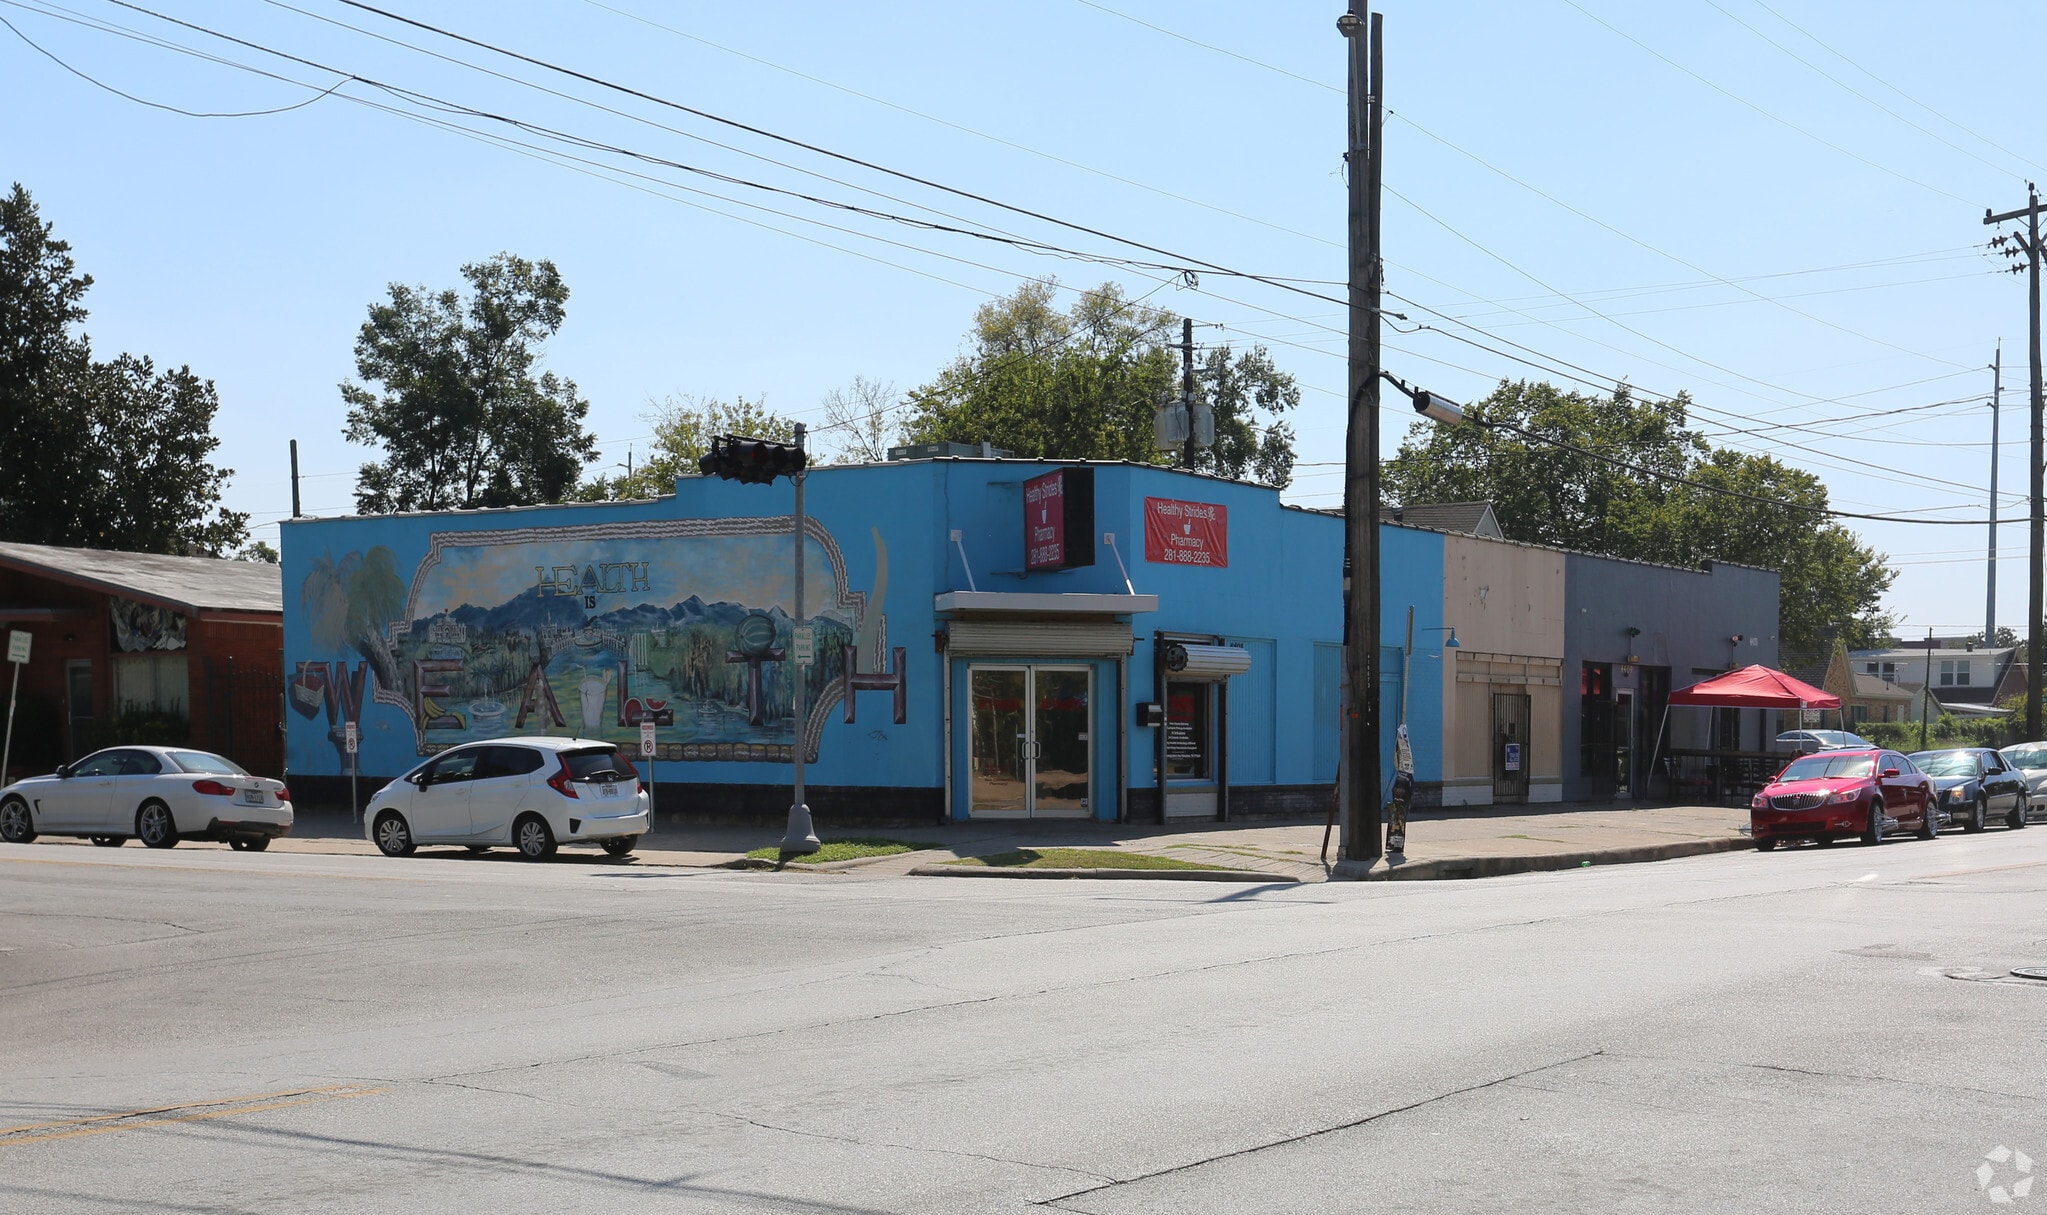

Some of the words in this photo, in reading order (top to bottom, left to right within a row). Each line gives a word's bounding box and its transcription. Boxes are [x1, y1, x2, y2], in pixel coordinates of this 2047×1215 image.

[1026, 485, 1041, 504] Healthy
[1042, 481, 1057, 499] Strides
[1157, 502, 1183, 519] Healthy
[1184, 504, 1207, 519] Strides
[1034, 526, 1055, 542] Pharmacy
[1170, 533, 1204, 550] Pharmacy
[1164, 548, 1210, 563] 281-888-2235
[535, 562, 651, 598] HEALTH
[585, 596, 596, 609] IS
